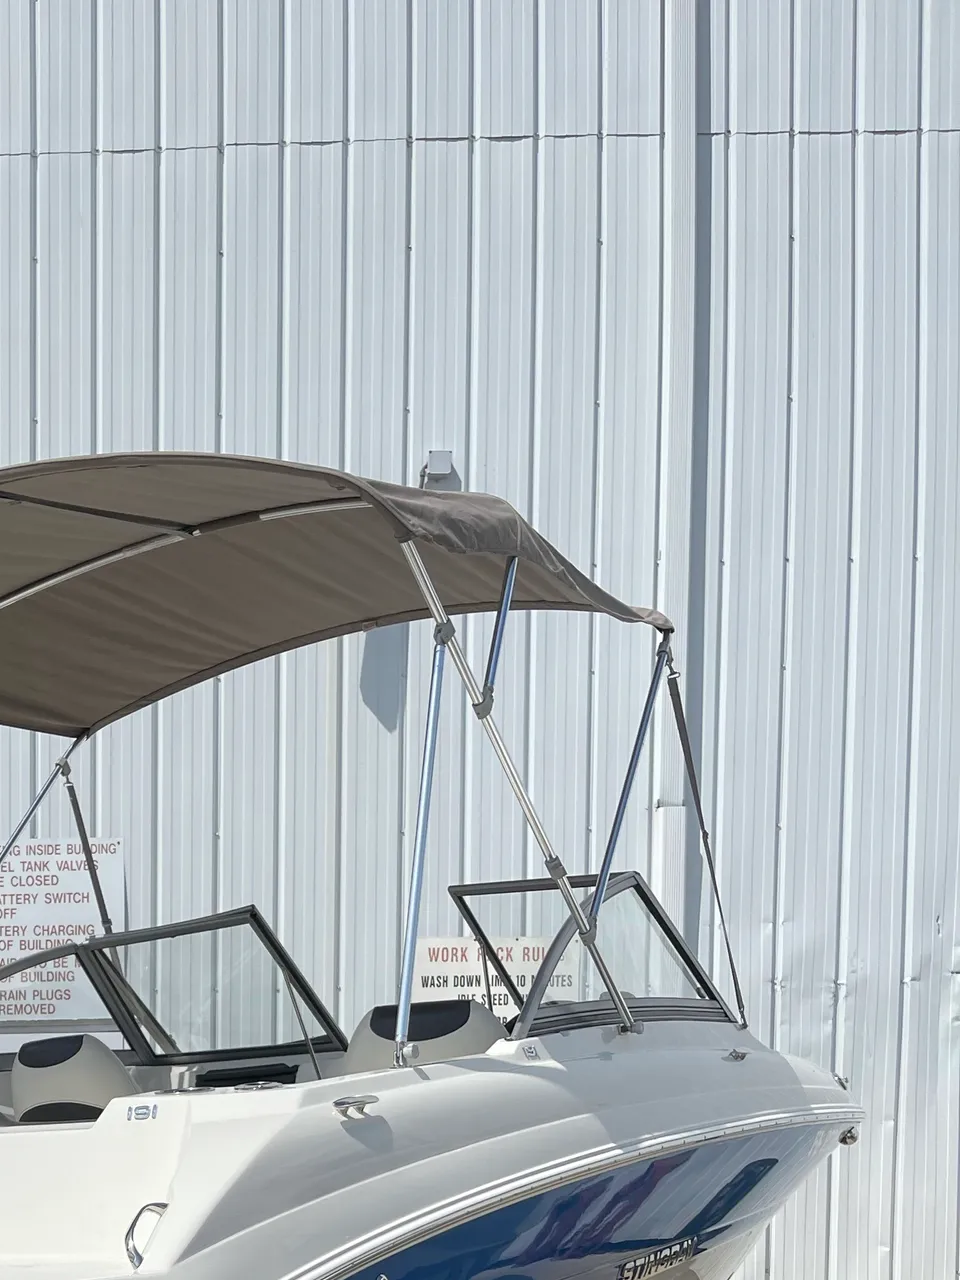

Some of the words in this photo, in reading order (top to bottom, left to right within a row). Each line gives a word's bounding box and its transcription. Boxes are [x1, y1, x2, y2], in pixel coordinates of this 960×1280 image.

[25, 843, 61, 856] INSIDE
[66, 843, 117, 855] BUDING
[20, 860, 50, 873] TANK
[56, 859, 99, 872] VALVES
[10, 874, 59, 887] CLOSED
[44, 892, 90, 905] SWITCH
[33, 924, 95, 936] CHARGING
[428, 947, 468, 962] WORK
[477, 946, 513, 962] RCK
[523, 946, 564, 962] RUL
[53, 957, 69, 969] BE
[20, 970, 75, 983] BUILDING
[421, 975, 449, 988] WASH
[453, 974, 481, 988] DOWN
[516, 974, 526, 988] 10
[531, 974, 573, 988] UTES
[32, 988, 71, 1001] PLUGS
[481, 993, 509, 1006] SEED
